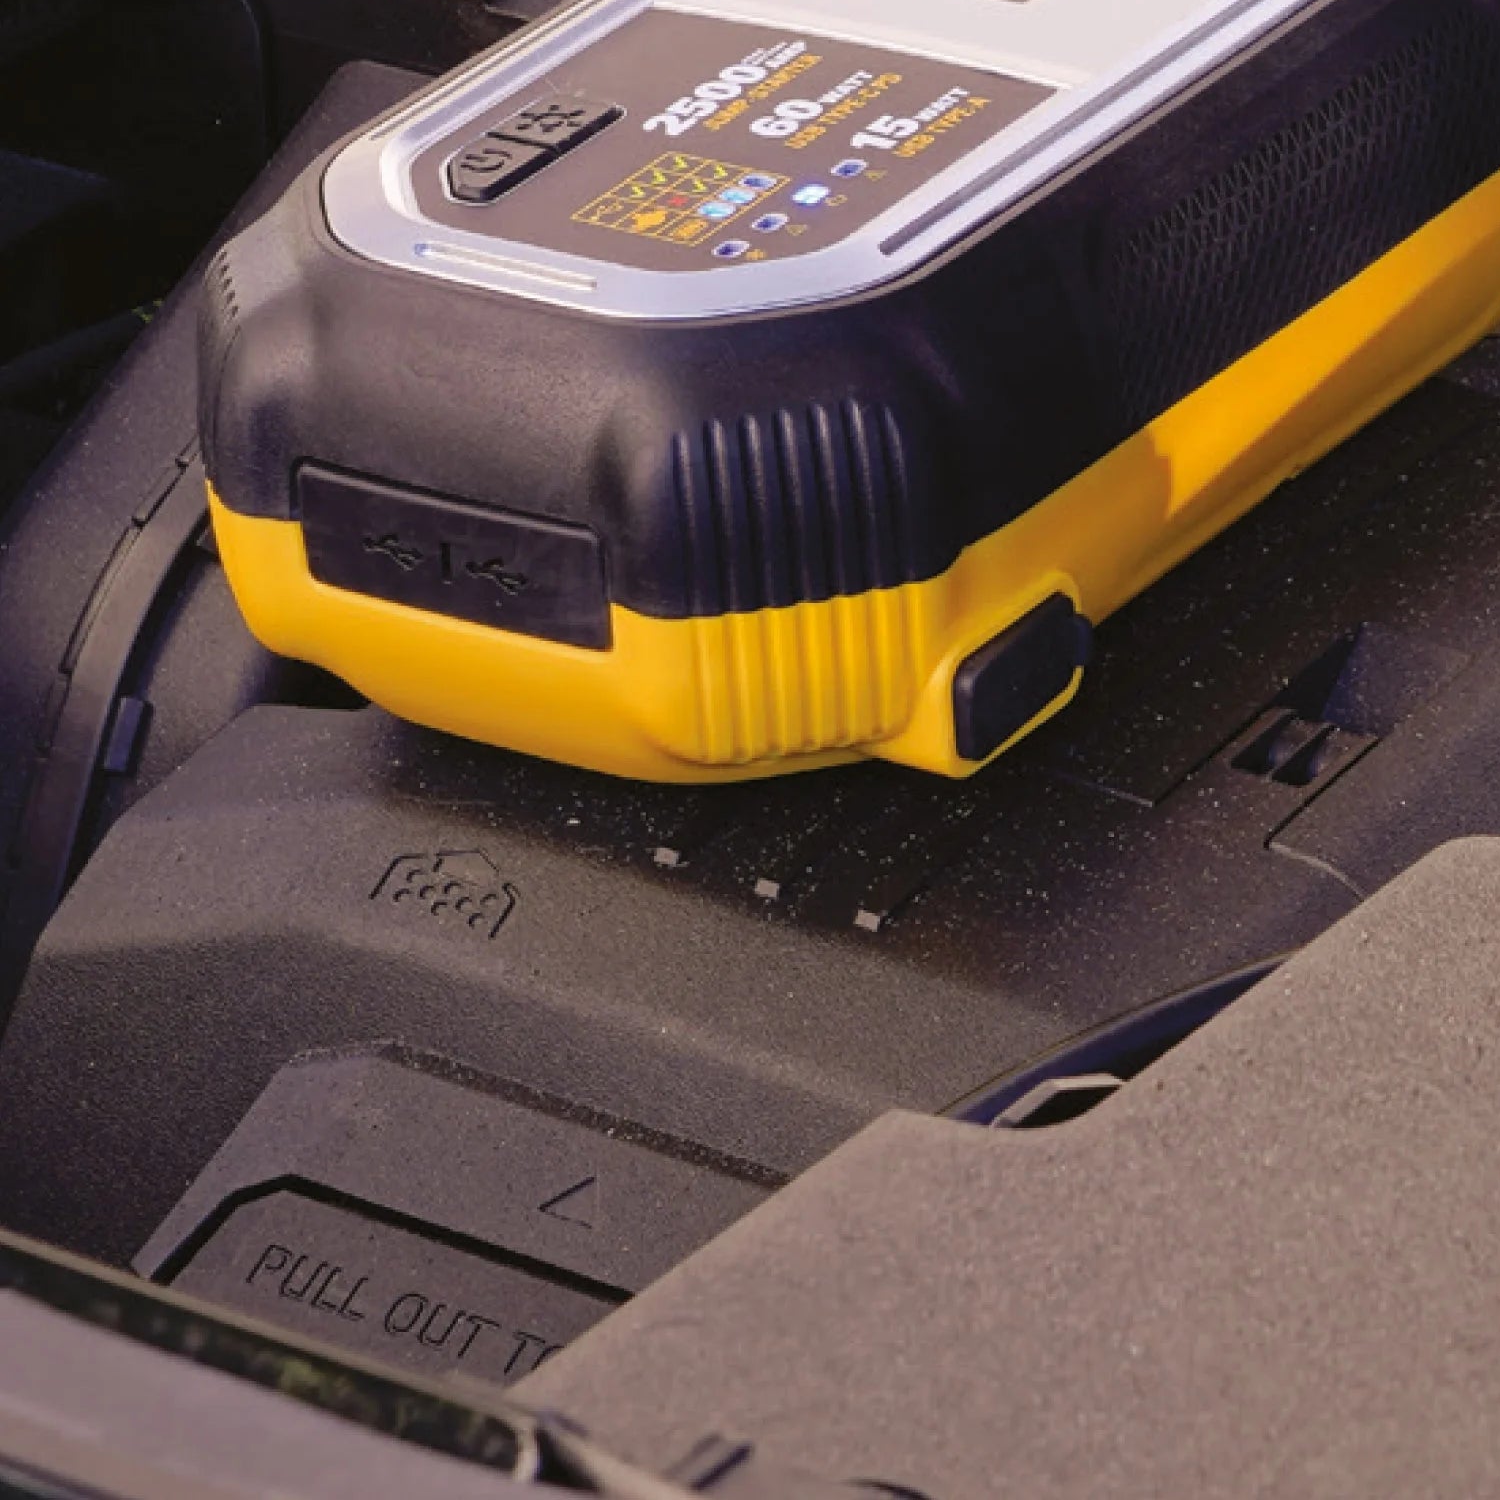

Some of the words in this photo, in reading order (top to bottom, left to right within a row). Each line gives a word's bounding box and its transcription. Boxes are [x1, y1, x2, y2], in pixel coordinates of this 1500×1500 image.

[643, 65, 768, 136] 2500
[749, 99, 824, 137] 60
[850, 115, 920, 149] 15
[245, 1243, 369, 1322] PULL
[383, 1292, 501, 1360] OUT
